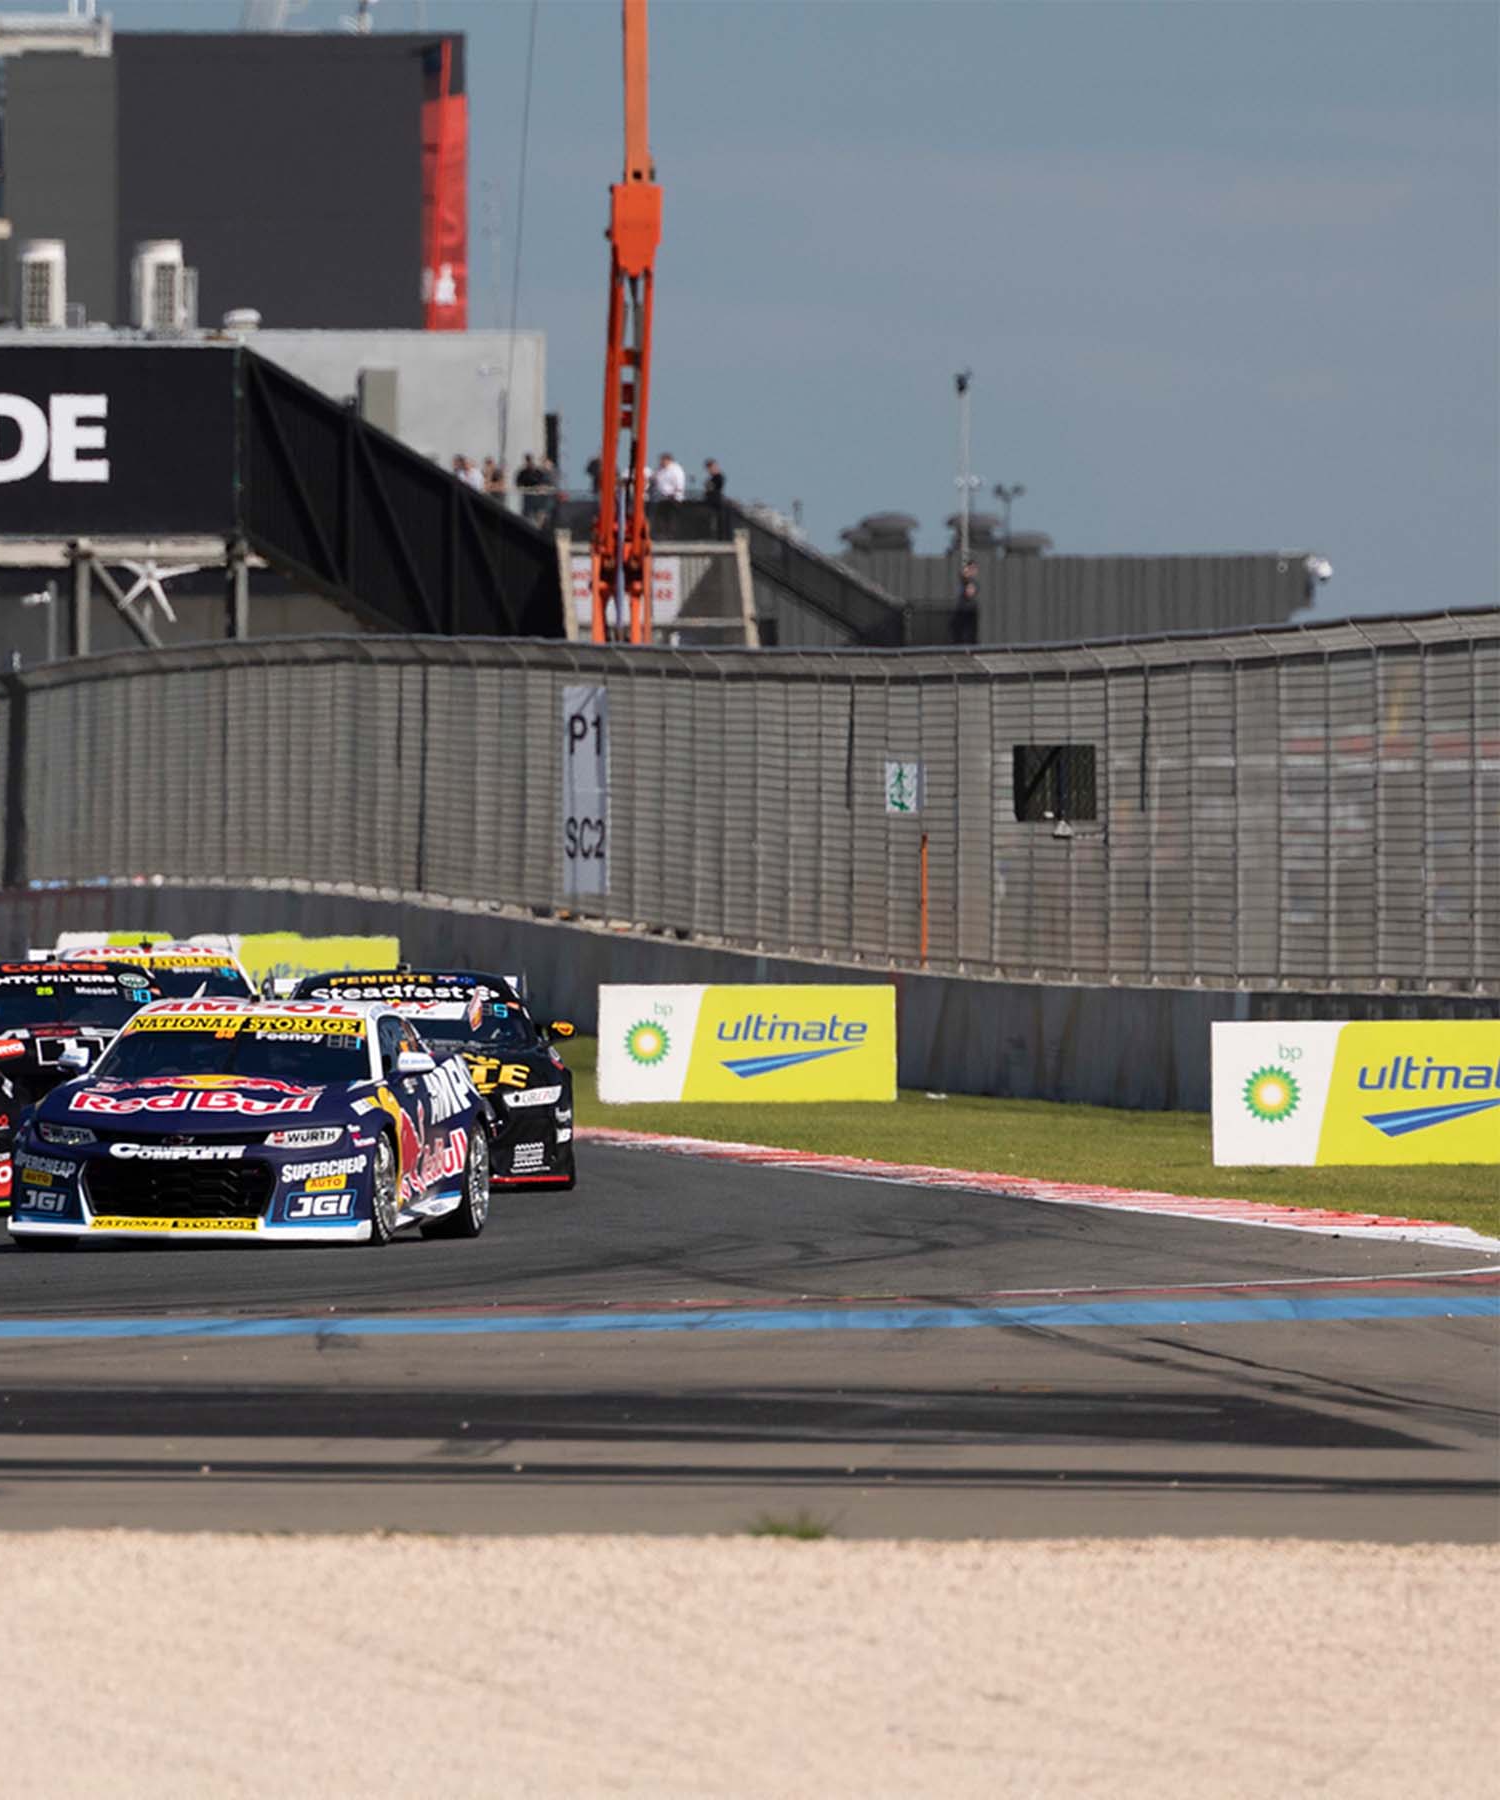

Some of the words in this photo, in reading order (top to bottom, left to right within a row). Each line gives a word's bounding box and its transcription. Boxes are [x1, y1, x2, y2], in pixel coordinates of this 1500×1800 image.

[569, 713, 602, 756] P1
[565, 817, 605, 859] SC2
[329, 974, 434, 986] PENRITE
[310, 985, 464, 999] Steadfast
[653, 1002, 673, 1017] bp
[132, 1017, 238, 1031] NATIONAL
[249, 1018, 357, 1034] STORAGE
[716, 1014, 868, 1042] ultimate
[255, 1031, 324, 1044] Feeney
[1278, 1043, 1303, 1063] bp
[1357, 1056, 1500, 1091] ultima
[69, 1090, 189, 1114] Red
[190, 1090, 322, 1115] Bull
[281, 1154, 367, 1183] SUPERCHEAP
[311, 1179, 342, 1188] AUTO
[21, 1189, 67, 1212] JGI
[289, 1194, 352, 1218] JGI
